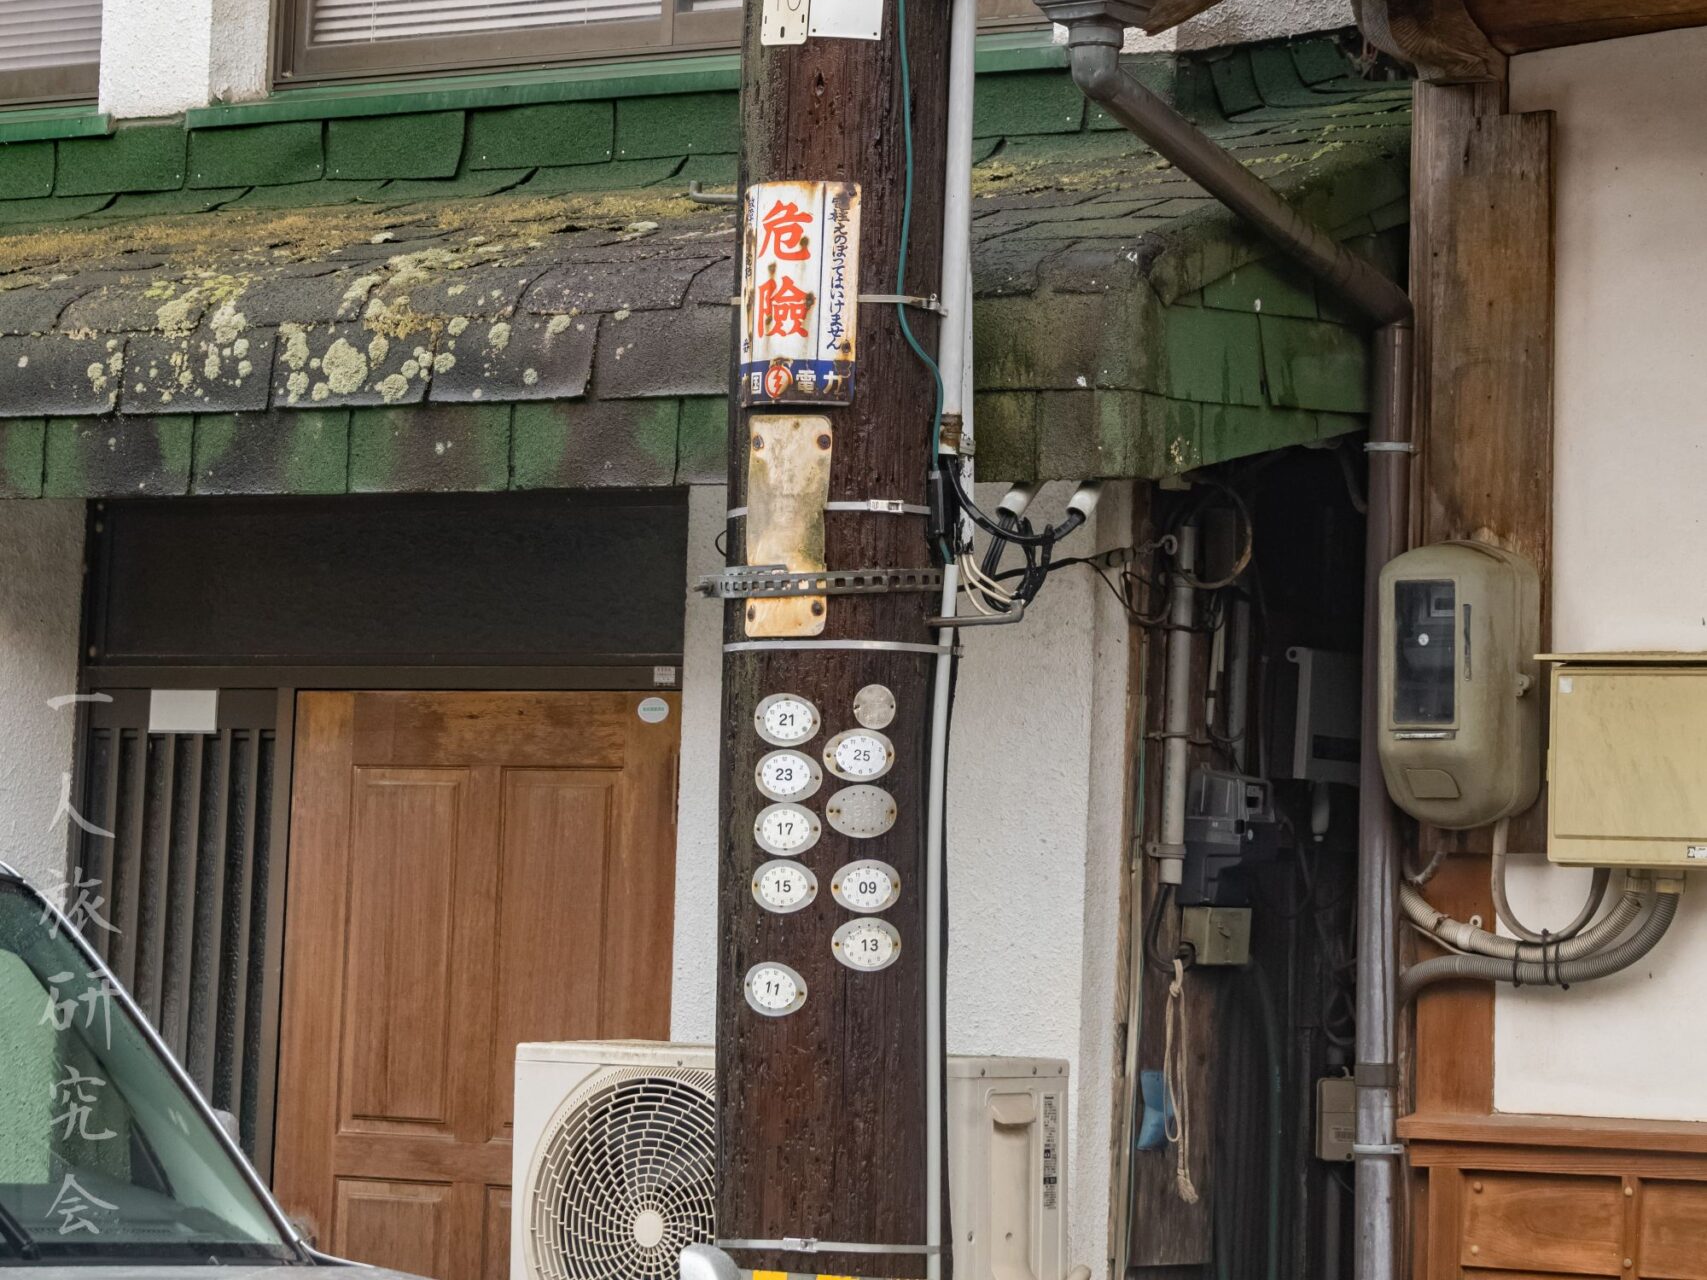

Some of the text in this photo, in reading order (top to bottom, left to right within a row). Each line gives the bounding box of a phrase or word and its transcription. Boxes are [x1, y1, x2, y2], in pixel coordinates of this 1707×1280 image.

[779, 713, 794, 727] 21
[853, 749, 871, 762] 25
[775, 768, 793, 781] 23
[777, 822, 794, 836] 17
[774, 879, 792, 893] 15
[858, 881, 877, 895] 09
[861, 938, 879, 952] 13
[766, 980, 780, 996] 11
